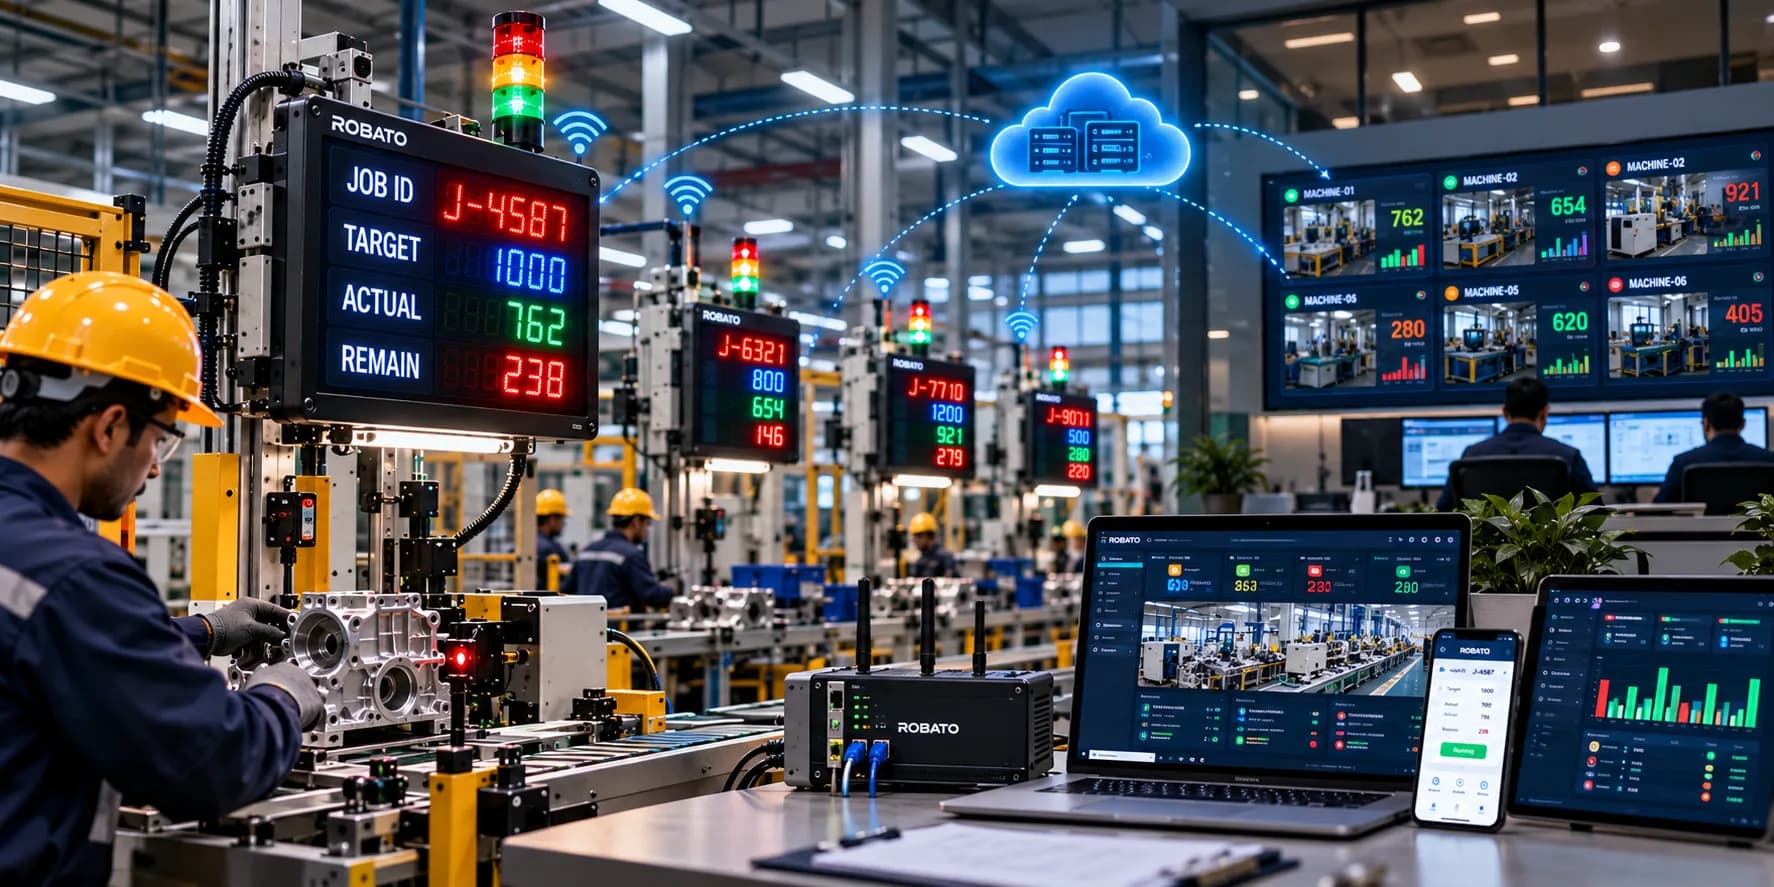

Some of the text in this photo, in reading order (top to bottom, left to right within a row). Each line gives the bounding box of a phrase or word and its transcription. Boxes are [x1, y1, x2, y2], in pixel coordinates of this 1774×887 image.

[331, 114, 408, 147] ROBATO
[1626, 157, 1685, 172] MACHINE-02
[1463, 172, 1518, 186] MACHINE-02
[1303, 185, 1355, 199] MACHINE-01
[1725, 181, 1760, 203] 921
[346, 165, 567, 242] JOB ID J-4587
[1551, 195, 1586, 216] 654
[1390, 208, 1424, 228] 762
[343, 223, 566, 294] TARGET 1000
[1629, 276, 1687, 289] MACHINE-06
[342, 284, 566, 346] ACTUAL 762
[702, 310, 741, 325] ROBATO
[1552, 311, 1588, 332] 620
[1725, 303, 1763, 324] 405
[1391, 319, 1425, 339] 280
[718, 334, 784, 365] J-6321
[341, 344, 565, 398] REMAIN 238
[892, 358, 924, 371] ROBATO
[752, 368, 784, 393] 800
[908, 378, 964, 401] J-7710
[752, 396, 784, 420] 654
[932, 404, 963, 424] 1200
[1046, 407, 1090, 427] J-9071
[757, 425, 784, 446] 146
[937, 425, 963, 445] 921
[1068, 428, 1090, 445] 500
[937, 448, 963, 467] 279
[1068, 446, 1090, 462] 280
[1068, 463, 1090, 479] 220
[897, 722, 960, 734] ROBATO
